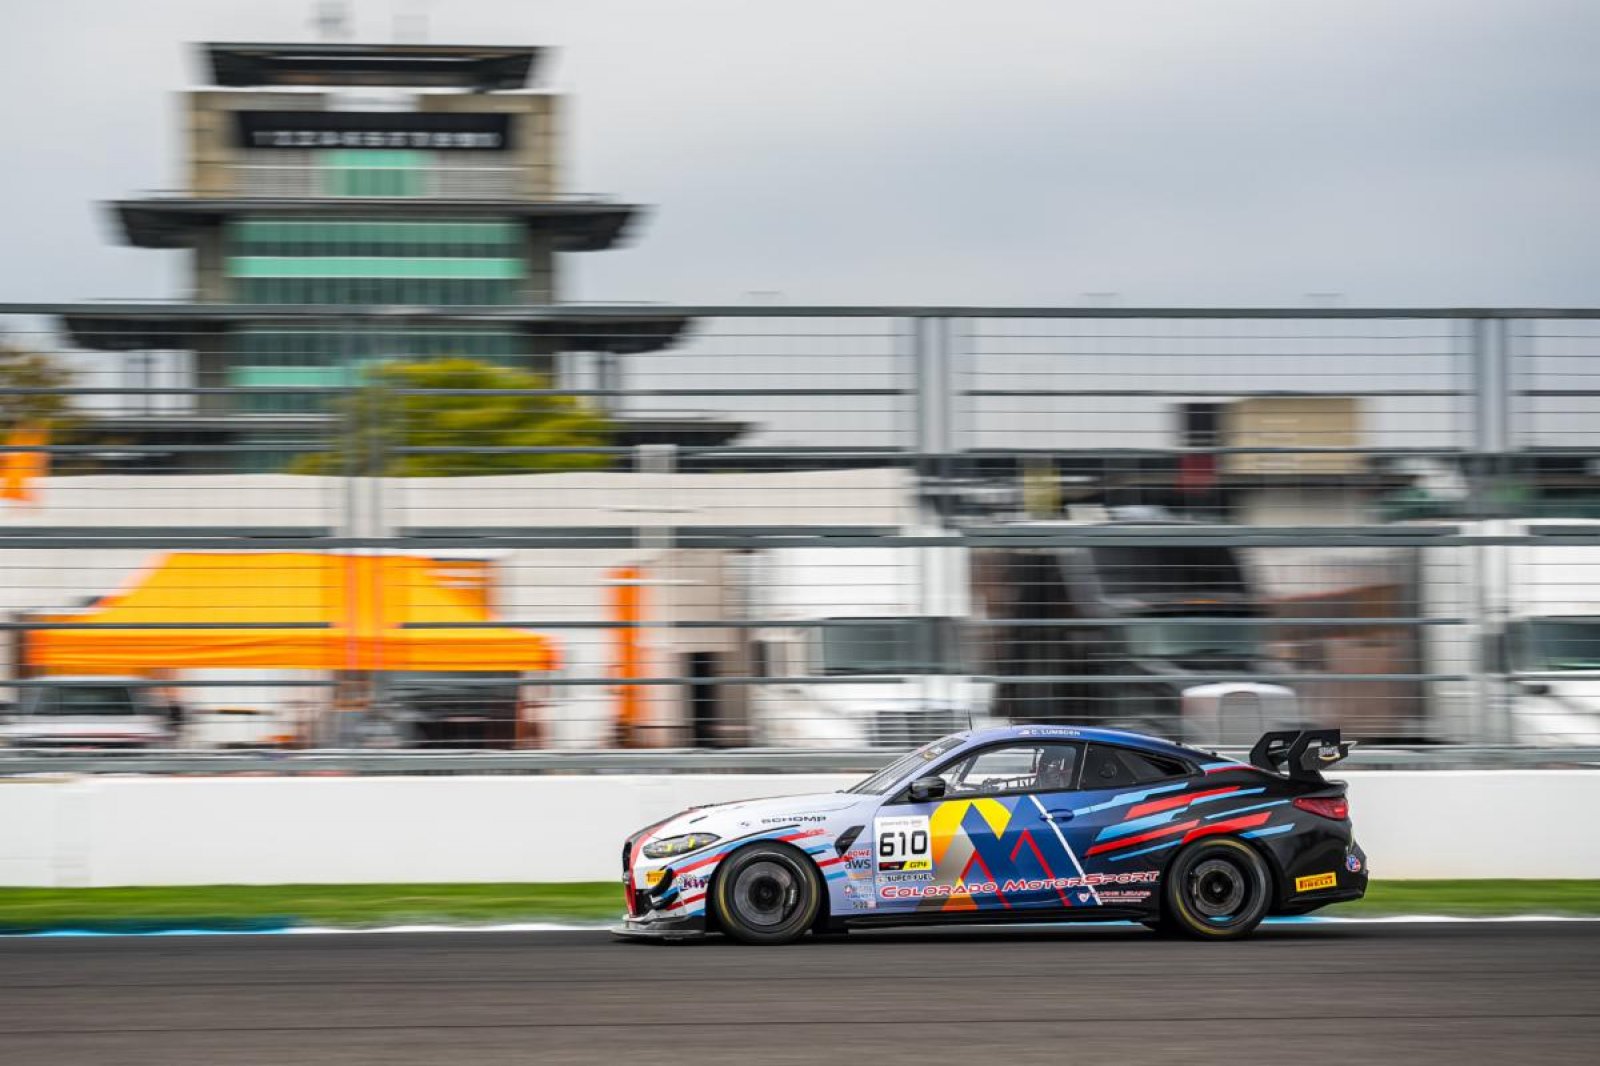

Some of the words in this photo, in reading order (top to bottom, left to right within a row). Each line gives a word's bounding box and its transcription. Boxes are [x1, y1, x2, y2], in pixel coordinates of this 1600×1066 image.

[761, 816, 827, 824] SCHOMP
[879, 830, 928, 857] 610
[1299, 875, 1332, 889] PIRELLI
